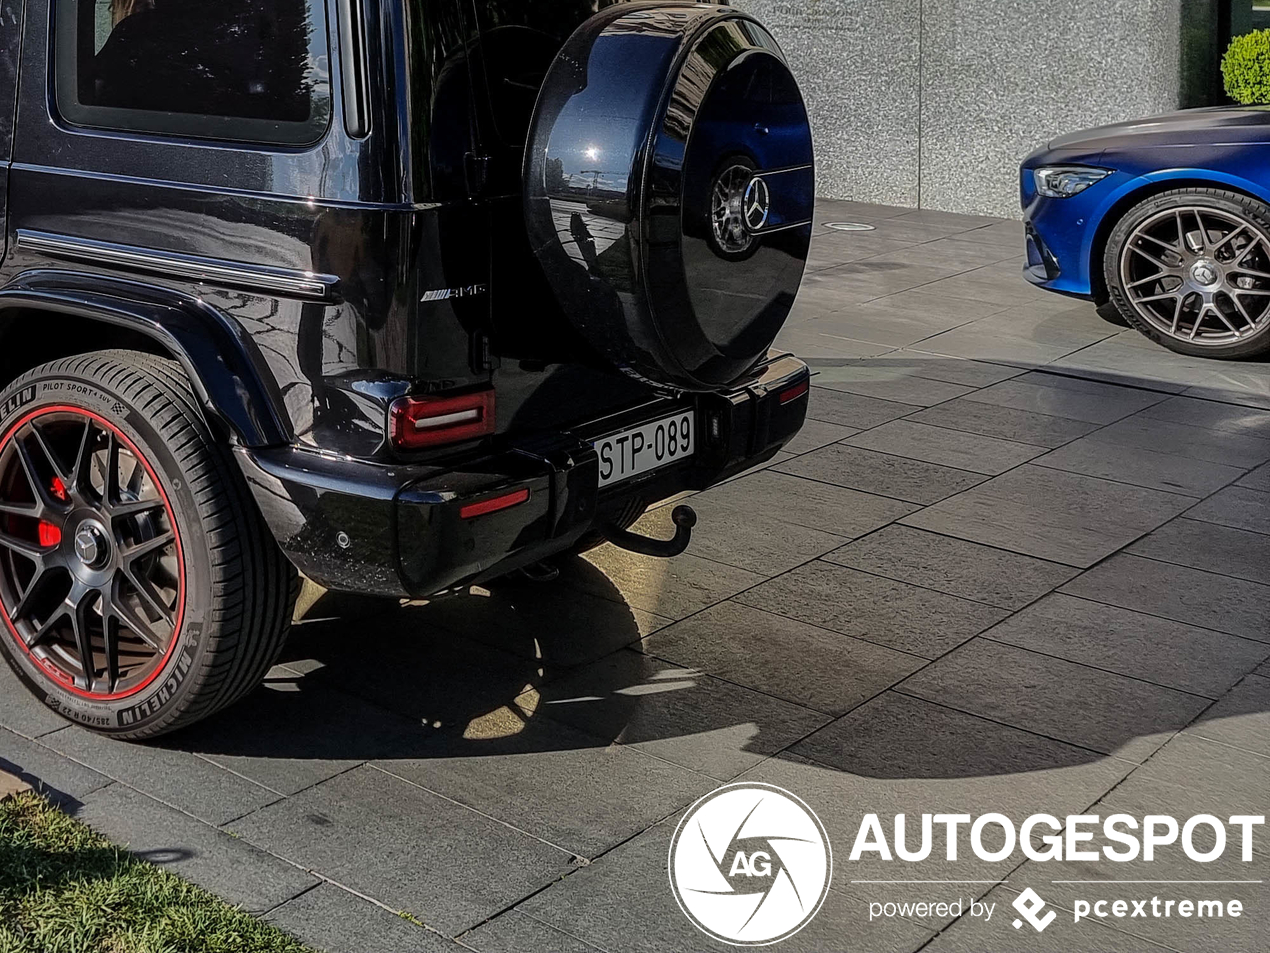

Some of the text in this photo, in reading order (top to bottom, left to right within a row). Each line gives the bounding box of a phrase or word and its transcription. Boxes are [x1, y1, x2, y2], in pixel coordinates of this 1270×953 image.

[43, 382, 65, 391] PILOT
[67, 383, 93, 396] SPORT
[99, 394, 111, 404] SUV
[600, 416, 690, 480] STP-089
[122, 650, 192, 725] MICHELIN
[62, 705, 72, 716] 22
[81, 714, 110, 726] 285/40
